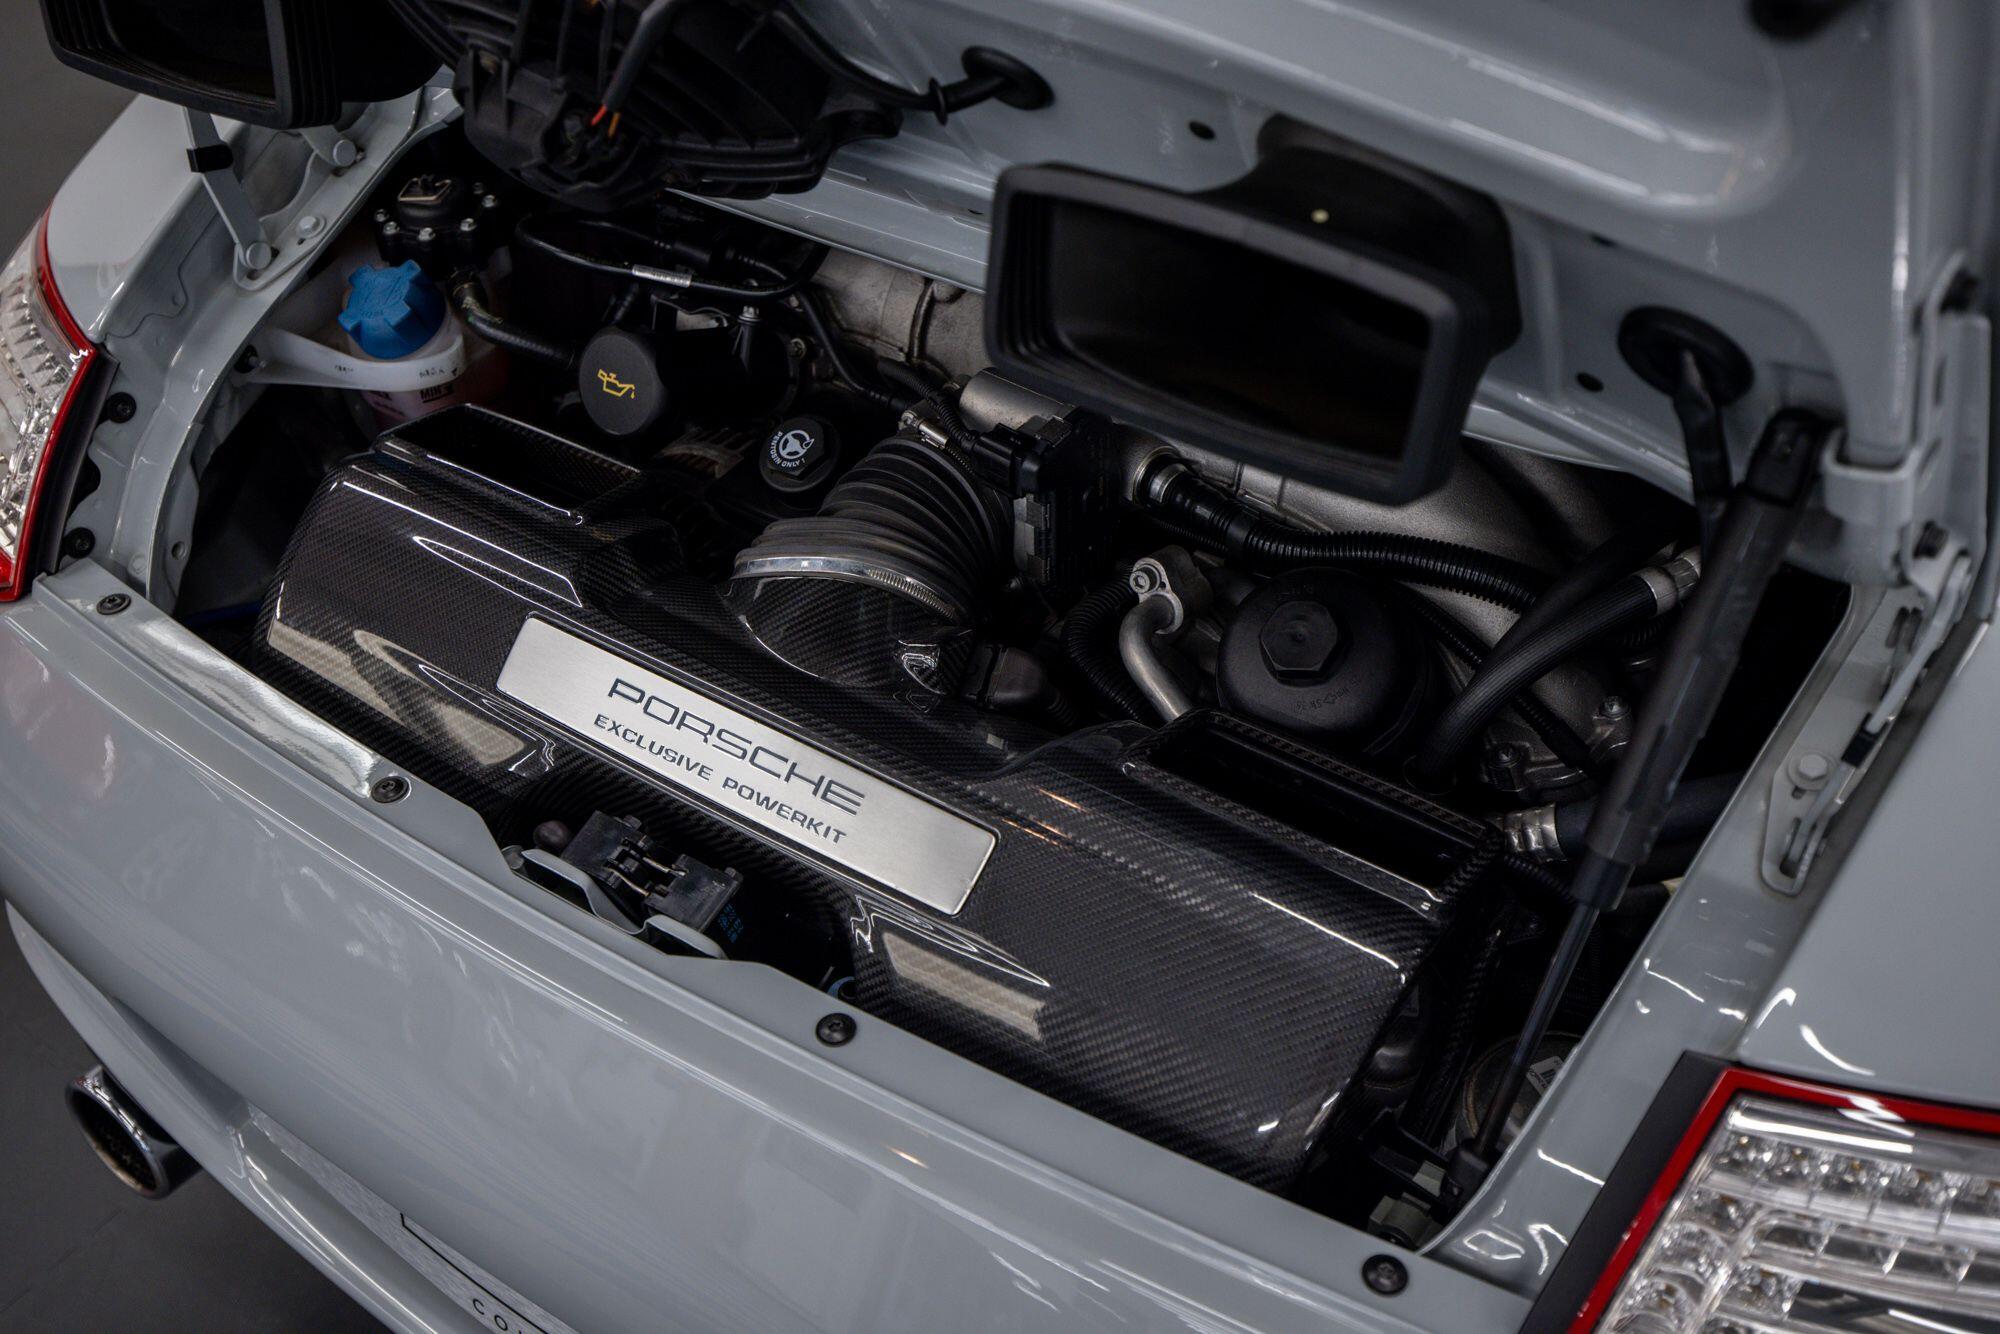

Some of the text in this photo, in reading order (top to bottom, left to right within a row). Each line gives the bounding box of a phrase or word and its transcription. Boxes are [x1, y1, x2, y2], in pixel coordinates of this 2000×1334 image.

[770, 430, 784, 465] PENTOSIN
[781, 460, 801, 468] ONLY
[594, 713, 848, 846] EXCLUSIVE POWERKIT
[607, 677, 866, 816] PORSCHE
[472, 1298, 522, 1334] CO
